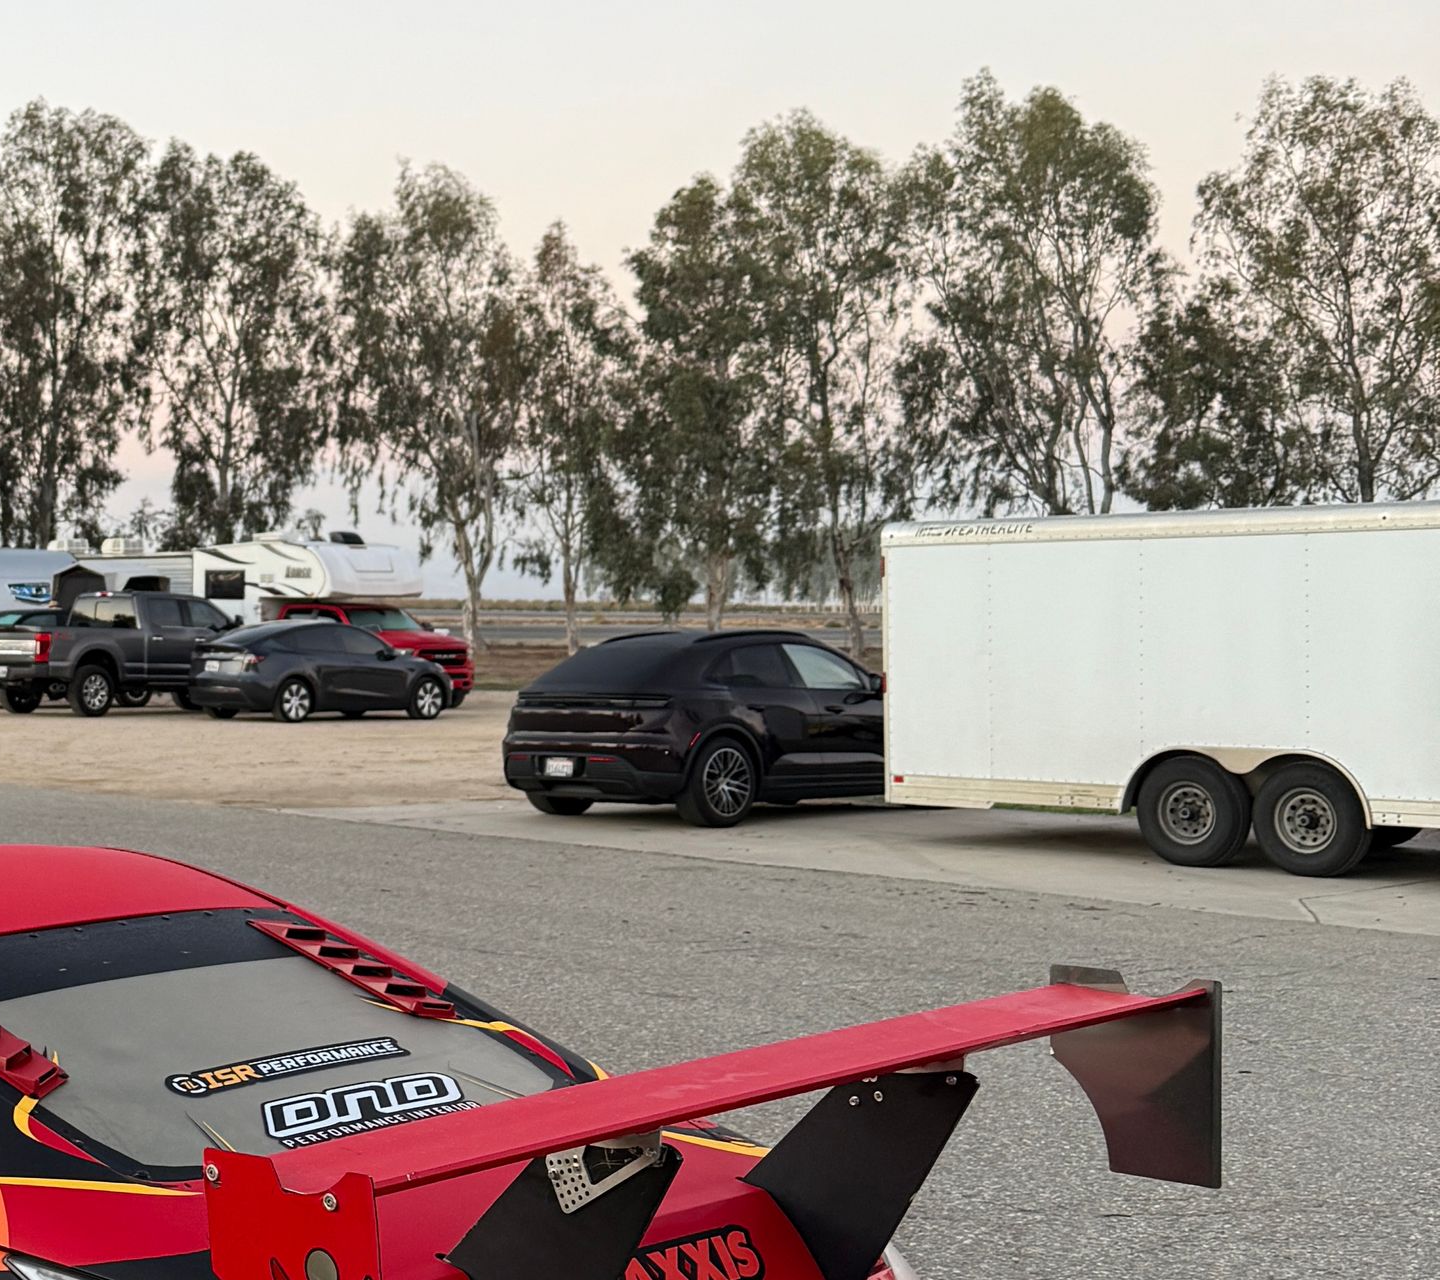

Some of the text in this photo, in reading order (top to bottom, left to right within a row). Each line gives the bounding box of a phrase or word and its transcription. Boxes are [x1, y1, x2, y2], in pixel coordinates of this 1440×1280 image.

[951, 524, 1033, 536] FEATHERLITE
[201, 1039, 399, 1089] ISR PERFORMANCE
[283, 1101, 481, 1147] PERFORMANCE INTERIOR
